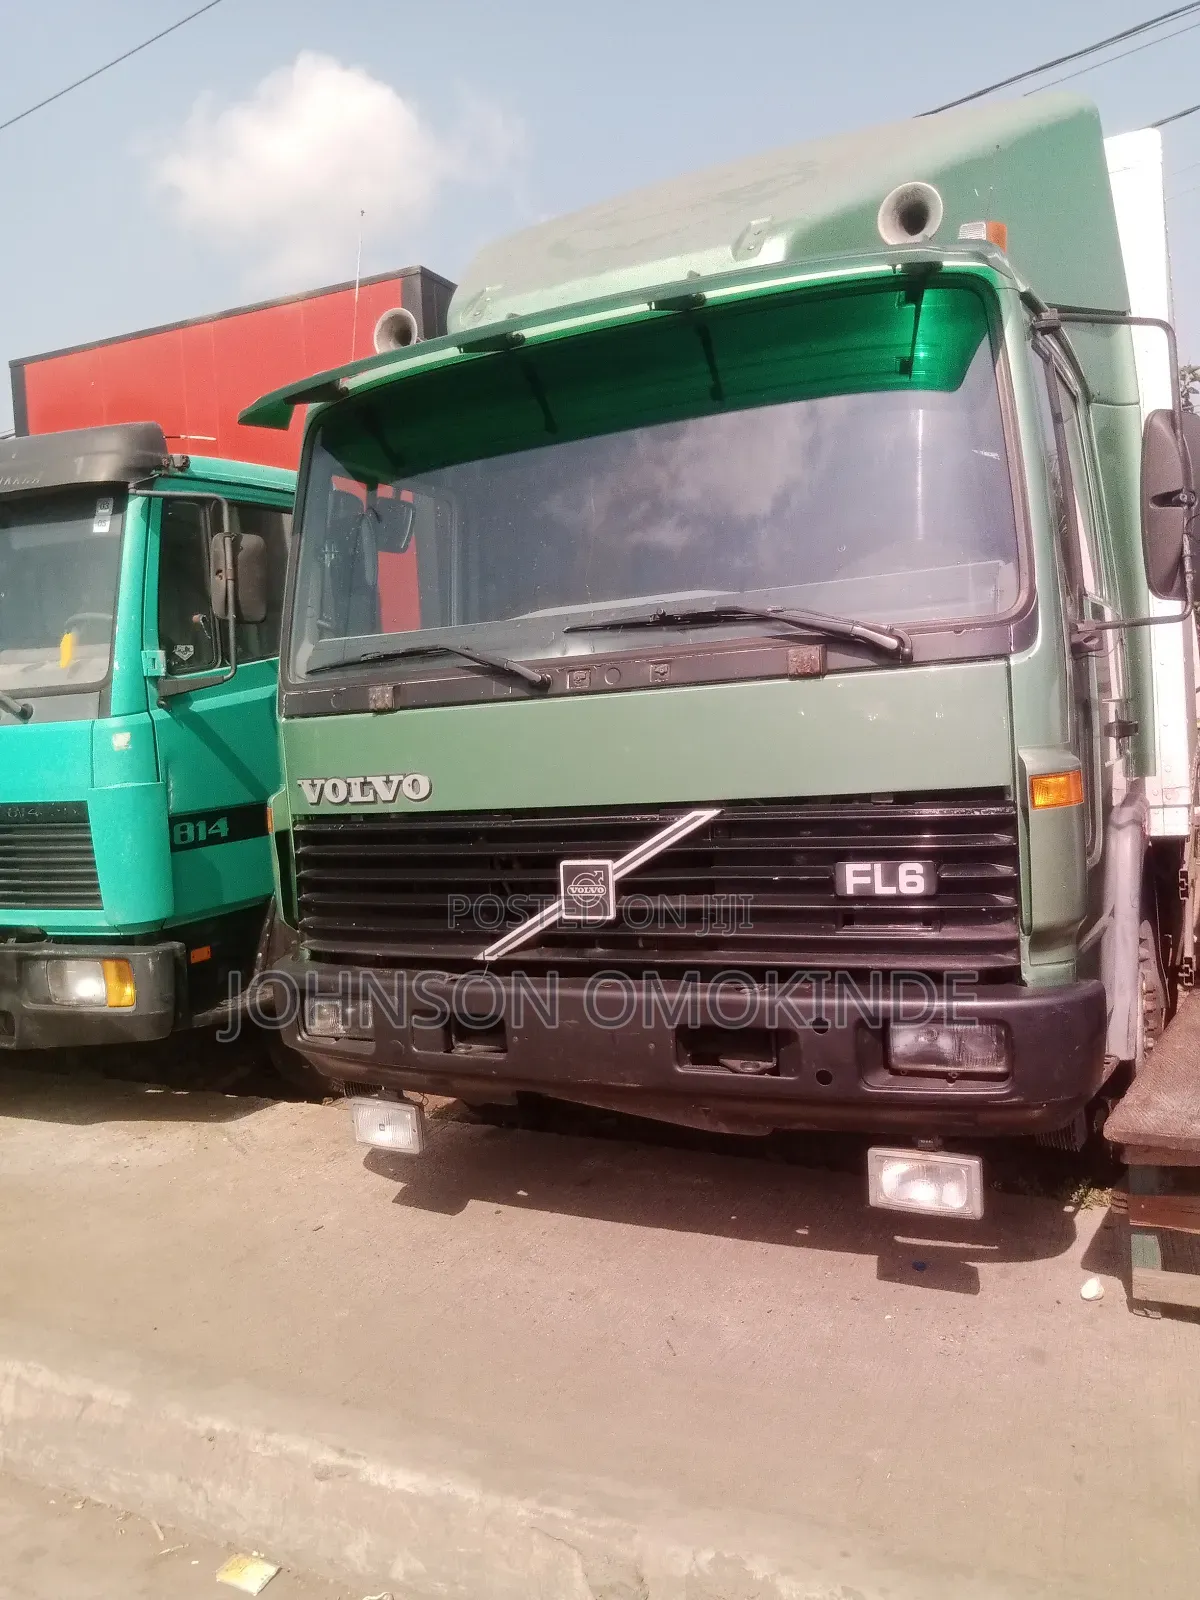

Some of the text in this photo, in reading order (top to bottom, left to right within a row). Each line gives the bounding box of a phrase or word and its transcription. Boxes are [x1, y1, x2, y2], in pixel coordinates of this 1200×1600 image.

[297, 772, 432, 806] VOLVO
[173, 816, 230, 845] 814
[569, 886, 605, 894] VOLVO
[845, 862, 925, 895] FL6
